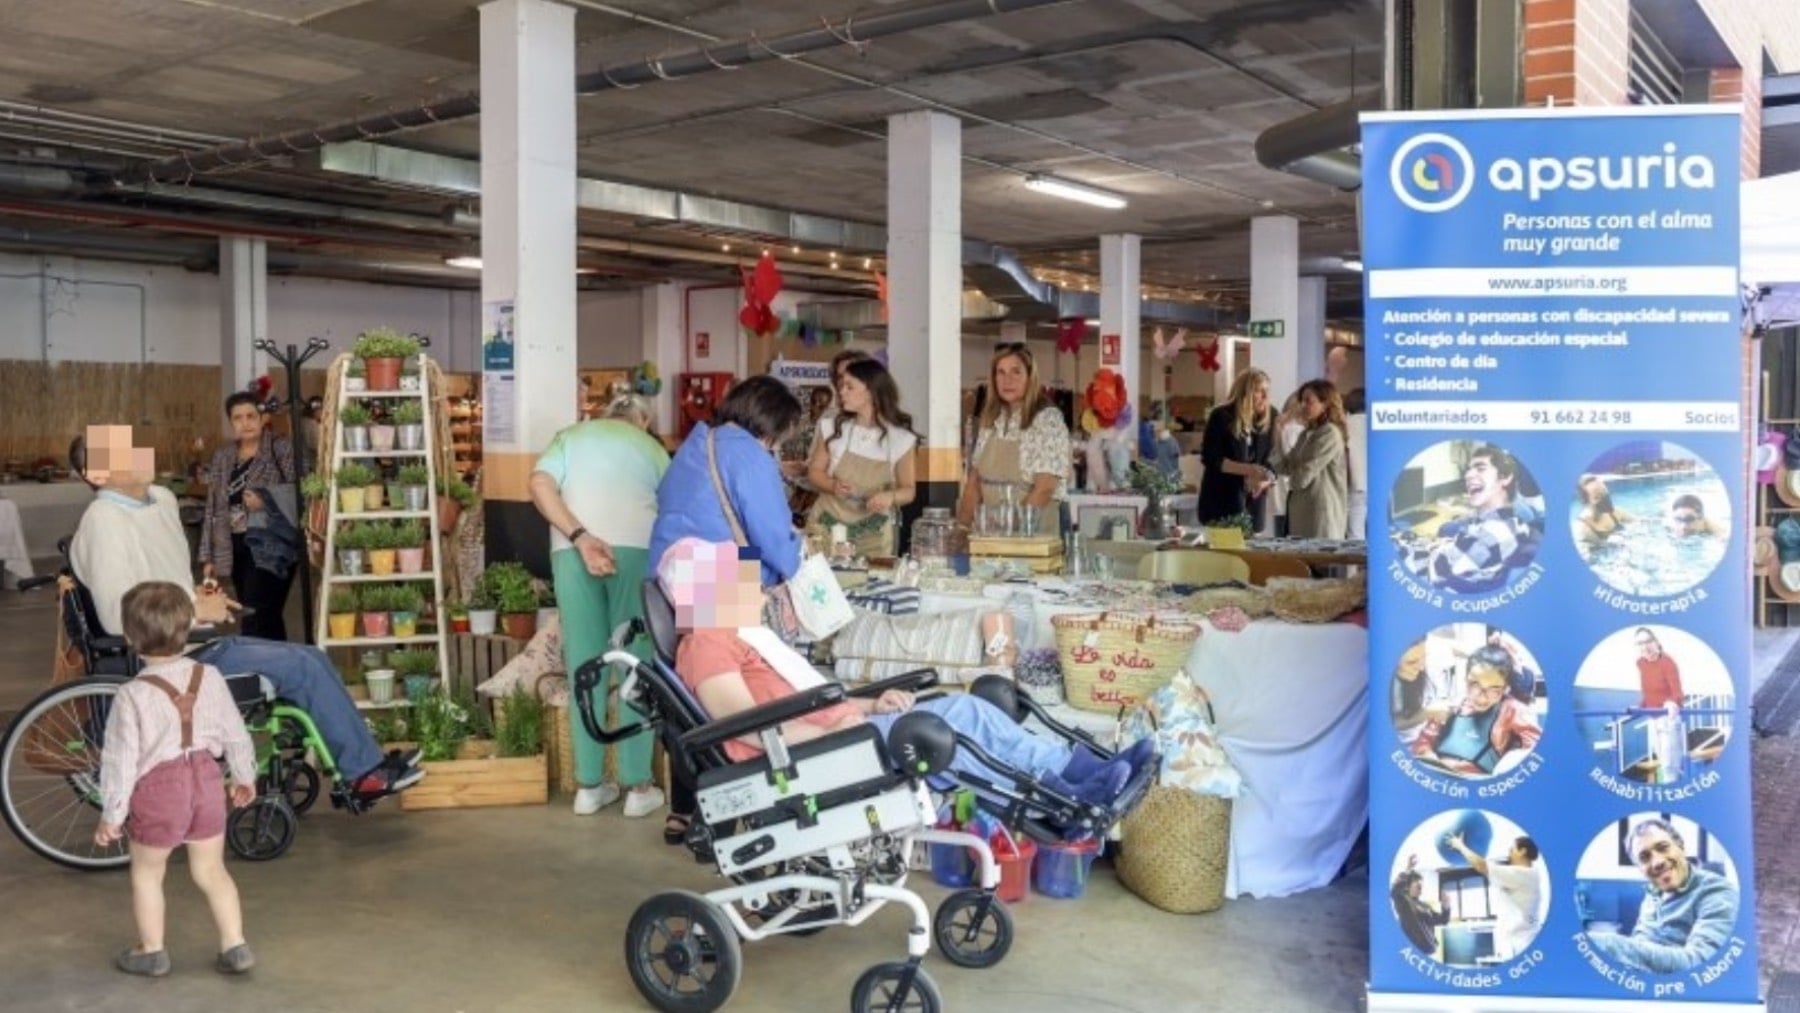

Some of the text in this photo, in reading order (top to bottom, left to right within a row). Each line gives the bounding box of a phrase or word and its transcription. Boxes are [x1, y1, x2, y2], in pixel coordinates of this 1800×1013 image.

[1488, 141, 1714, 200] apsuria
[1503, 209, 1712, 230] Personas con el alma
[1503, 232, 1621, 255] muy grande
[1488, 274, 1628, 291] www.apsuria.org
[1382, 308, 1730, 326] Atención a personas con discapacidad severa
[1394, 331, 1628, 348] Colegio de educación especial
[1394, 355, 1446, 368] Centro
[1450, 354, 1469, 368] de
[1395, 377, 1477, 391] Residencia
[1376, 410, 1736, 424] Voluntariados 91 662 24 98 Socios
[1388, 560, 1546, 613] Terapia ocupacional
[1593, 584, 1709, 614] Hidroterapia
[1391, 750, 1545, 798] Educación especial
[1590, 767, 1721, 802] Rehabilitación
[1400, 948, 1544, 988] Actividades ocio
[1572, 932, 1746, 997] Formación pre laboral
